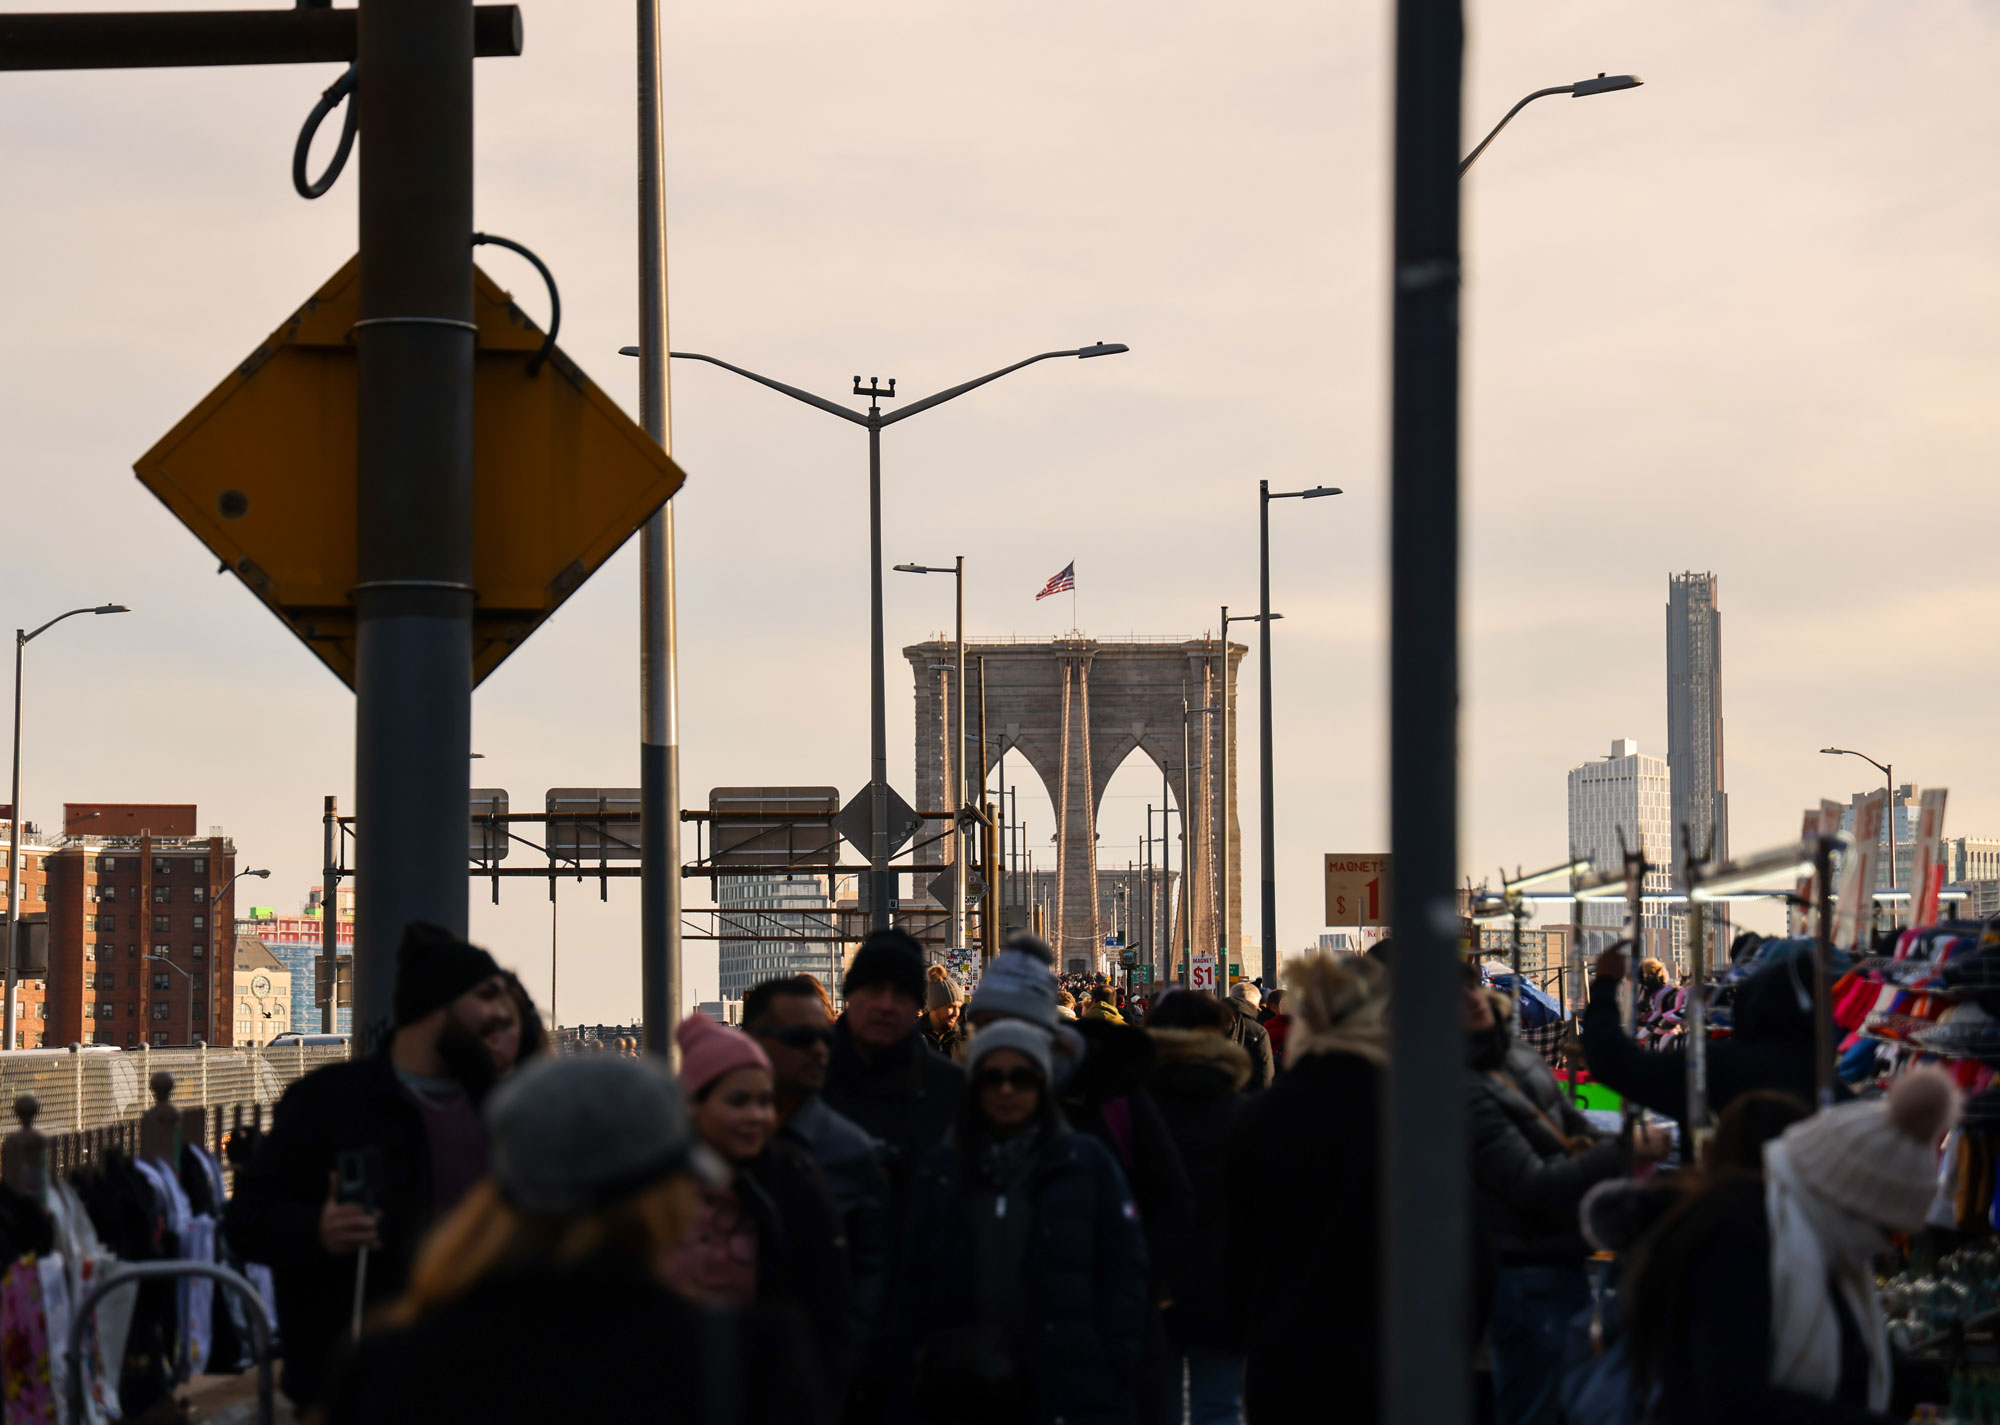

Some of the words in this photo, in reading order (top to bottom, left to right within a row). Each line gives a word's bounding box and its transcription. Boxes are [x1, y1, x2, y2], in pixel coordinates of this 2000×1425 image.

[1336, 895, 1346, 915] $
[1365, 877, 1379, 919] 1
[1194, 966, 1212, 988] $1
